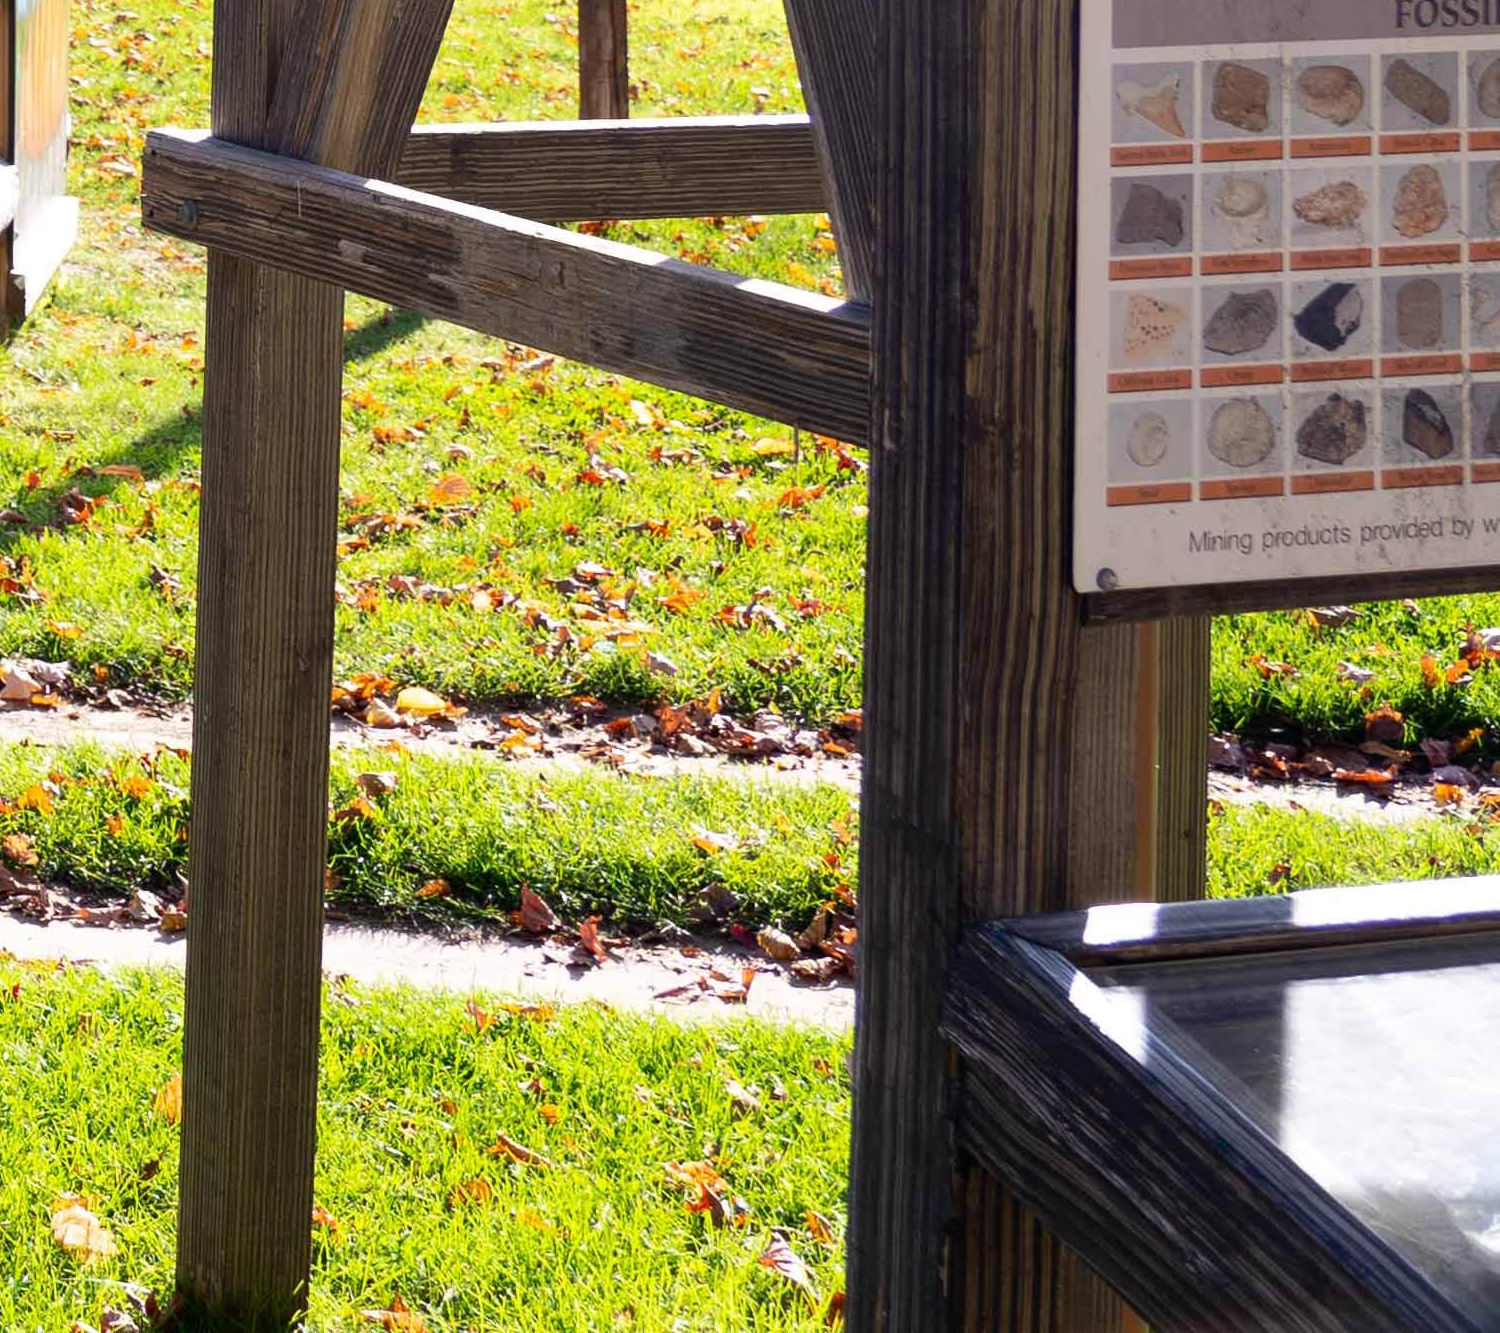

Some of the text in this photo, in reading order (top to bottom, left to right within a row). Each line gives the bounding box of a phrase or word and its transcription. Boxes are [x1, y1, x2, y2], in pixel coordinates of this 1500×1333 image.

[1188, 531, 1253, 555] Mining
[1262, 524, 1351, 551] products
[1360, 517, 1444, 543] provided
[1452, 518, 1475, 540] by
